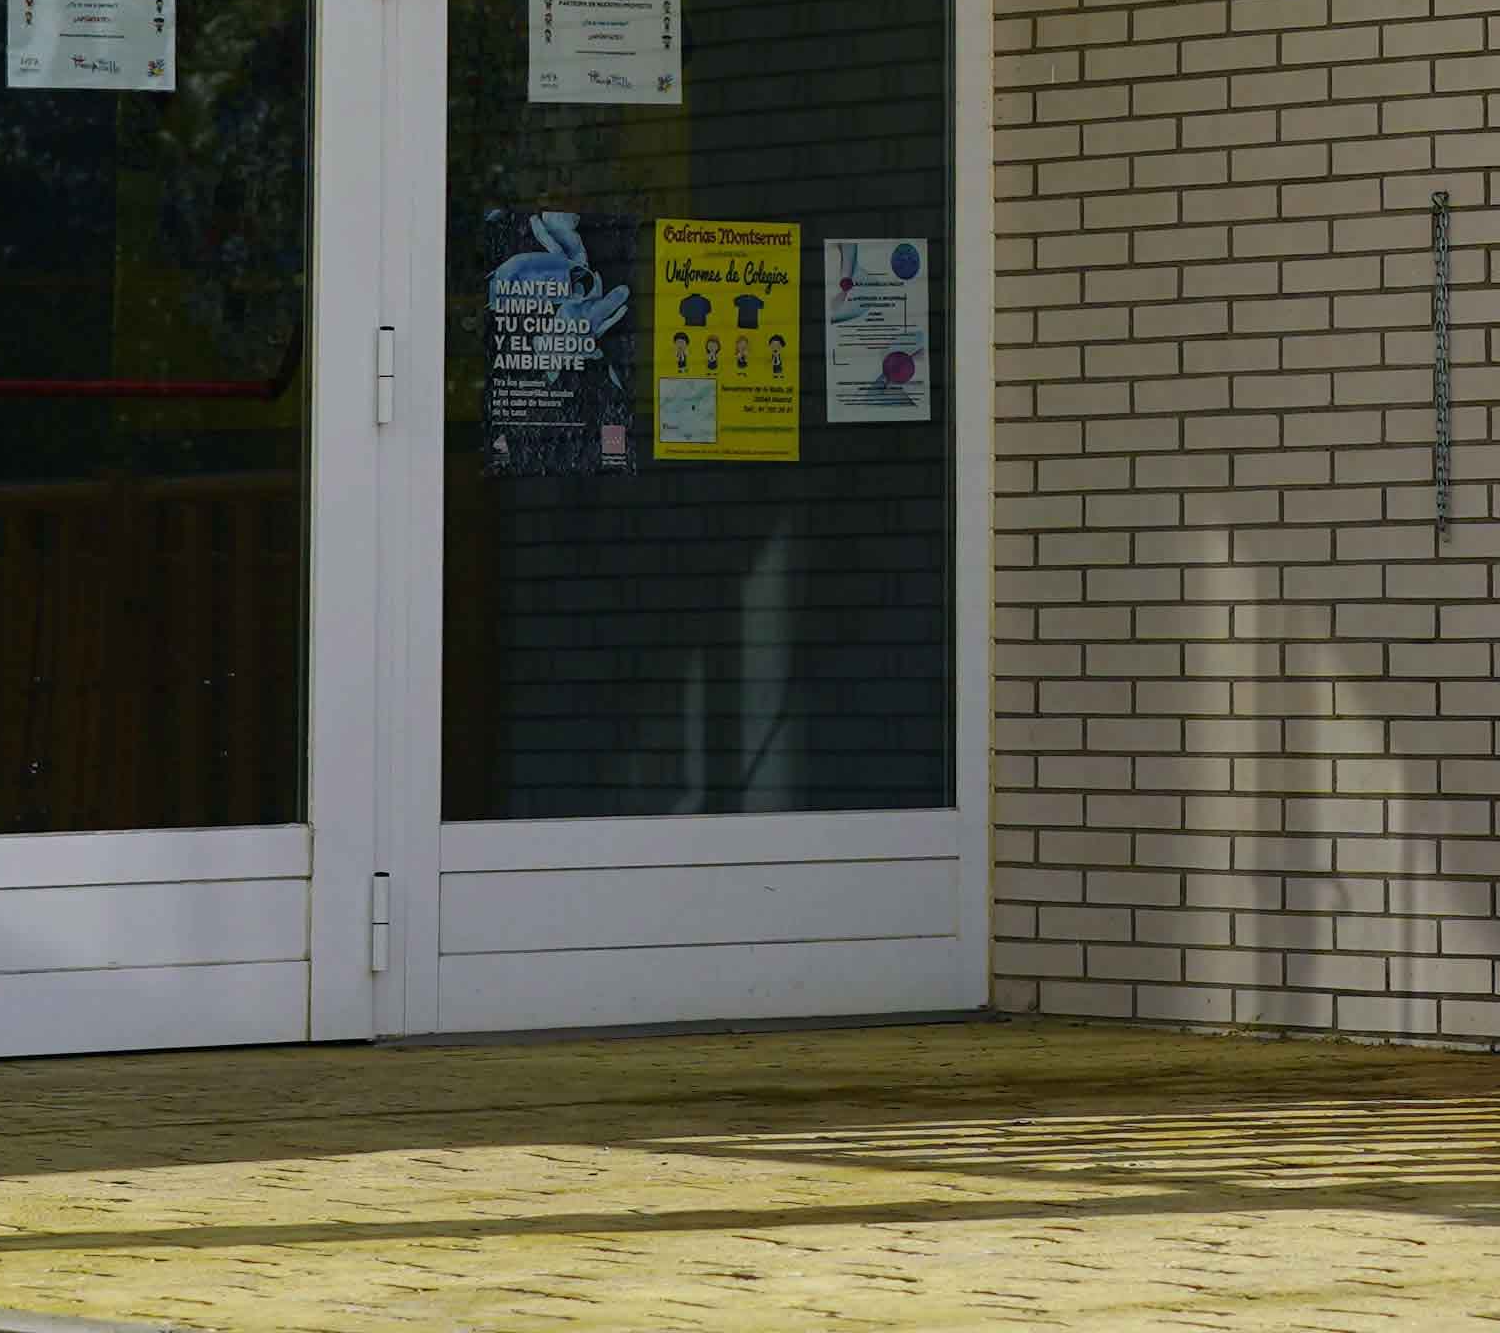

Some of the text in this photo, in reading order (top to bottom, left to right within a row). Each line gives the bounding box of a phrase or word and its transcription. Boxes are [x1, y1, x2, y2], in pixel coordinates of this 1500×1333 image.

[718, 228, 792, 245] Montserrat
[666, 258, 788, 294] Uniformes de Colegios
[496, 278, 570, 296] MANTÉN
[495, 299, 555, 315] LIMPIA
[495, 317, 590, 334] TU CIUDAD
[495, 336, 595, 353] Y EL MEDIO
[493, 354, 585, 371] AMBIENTE
